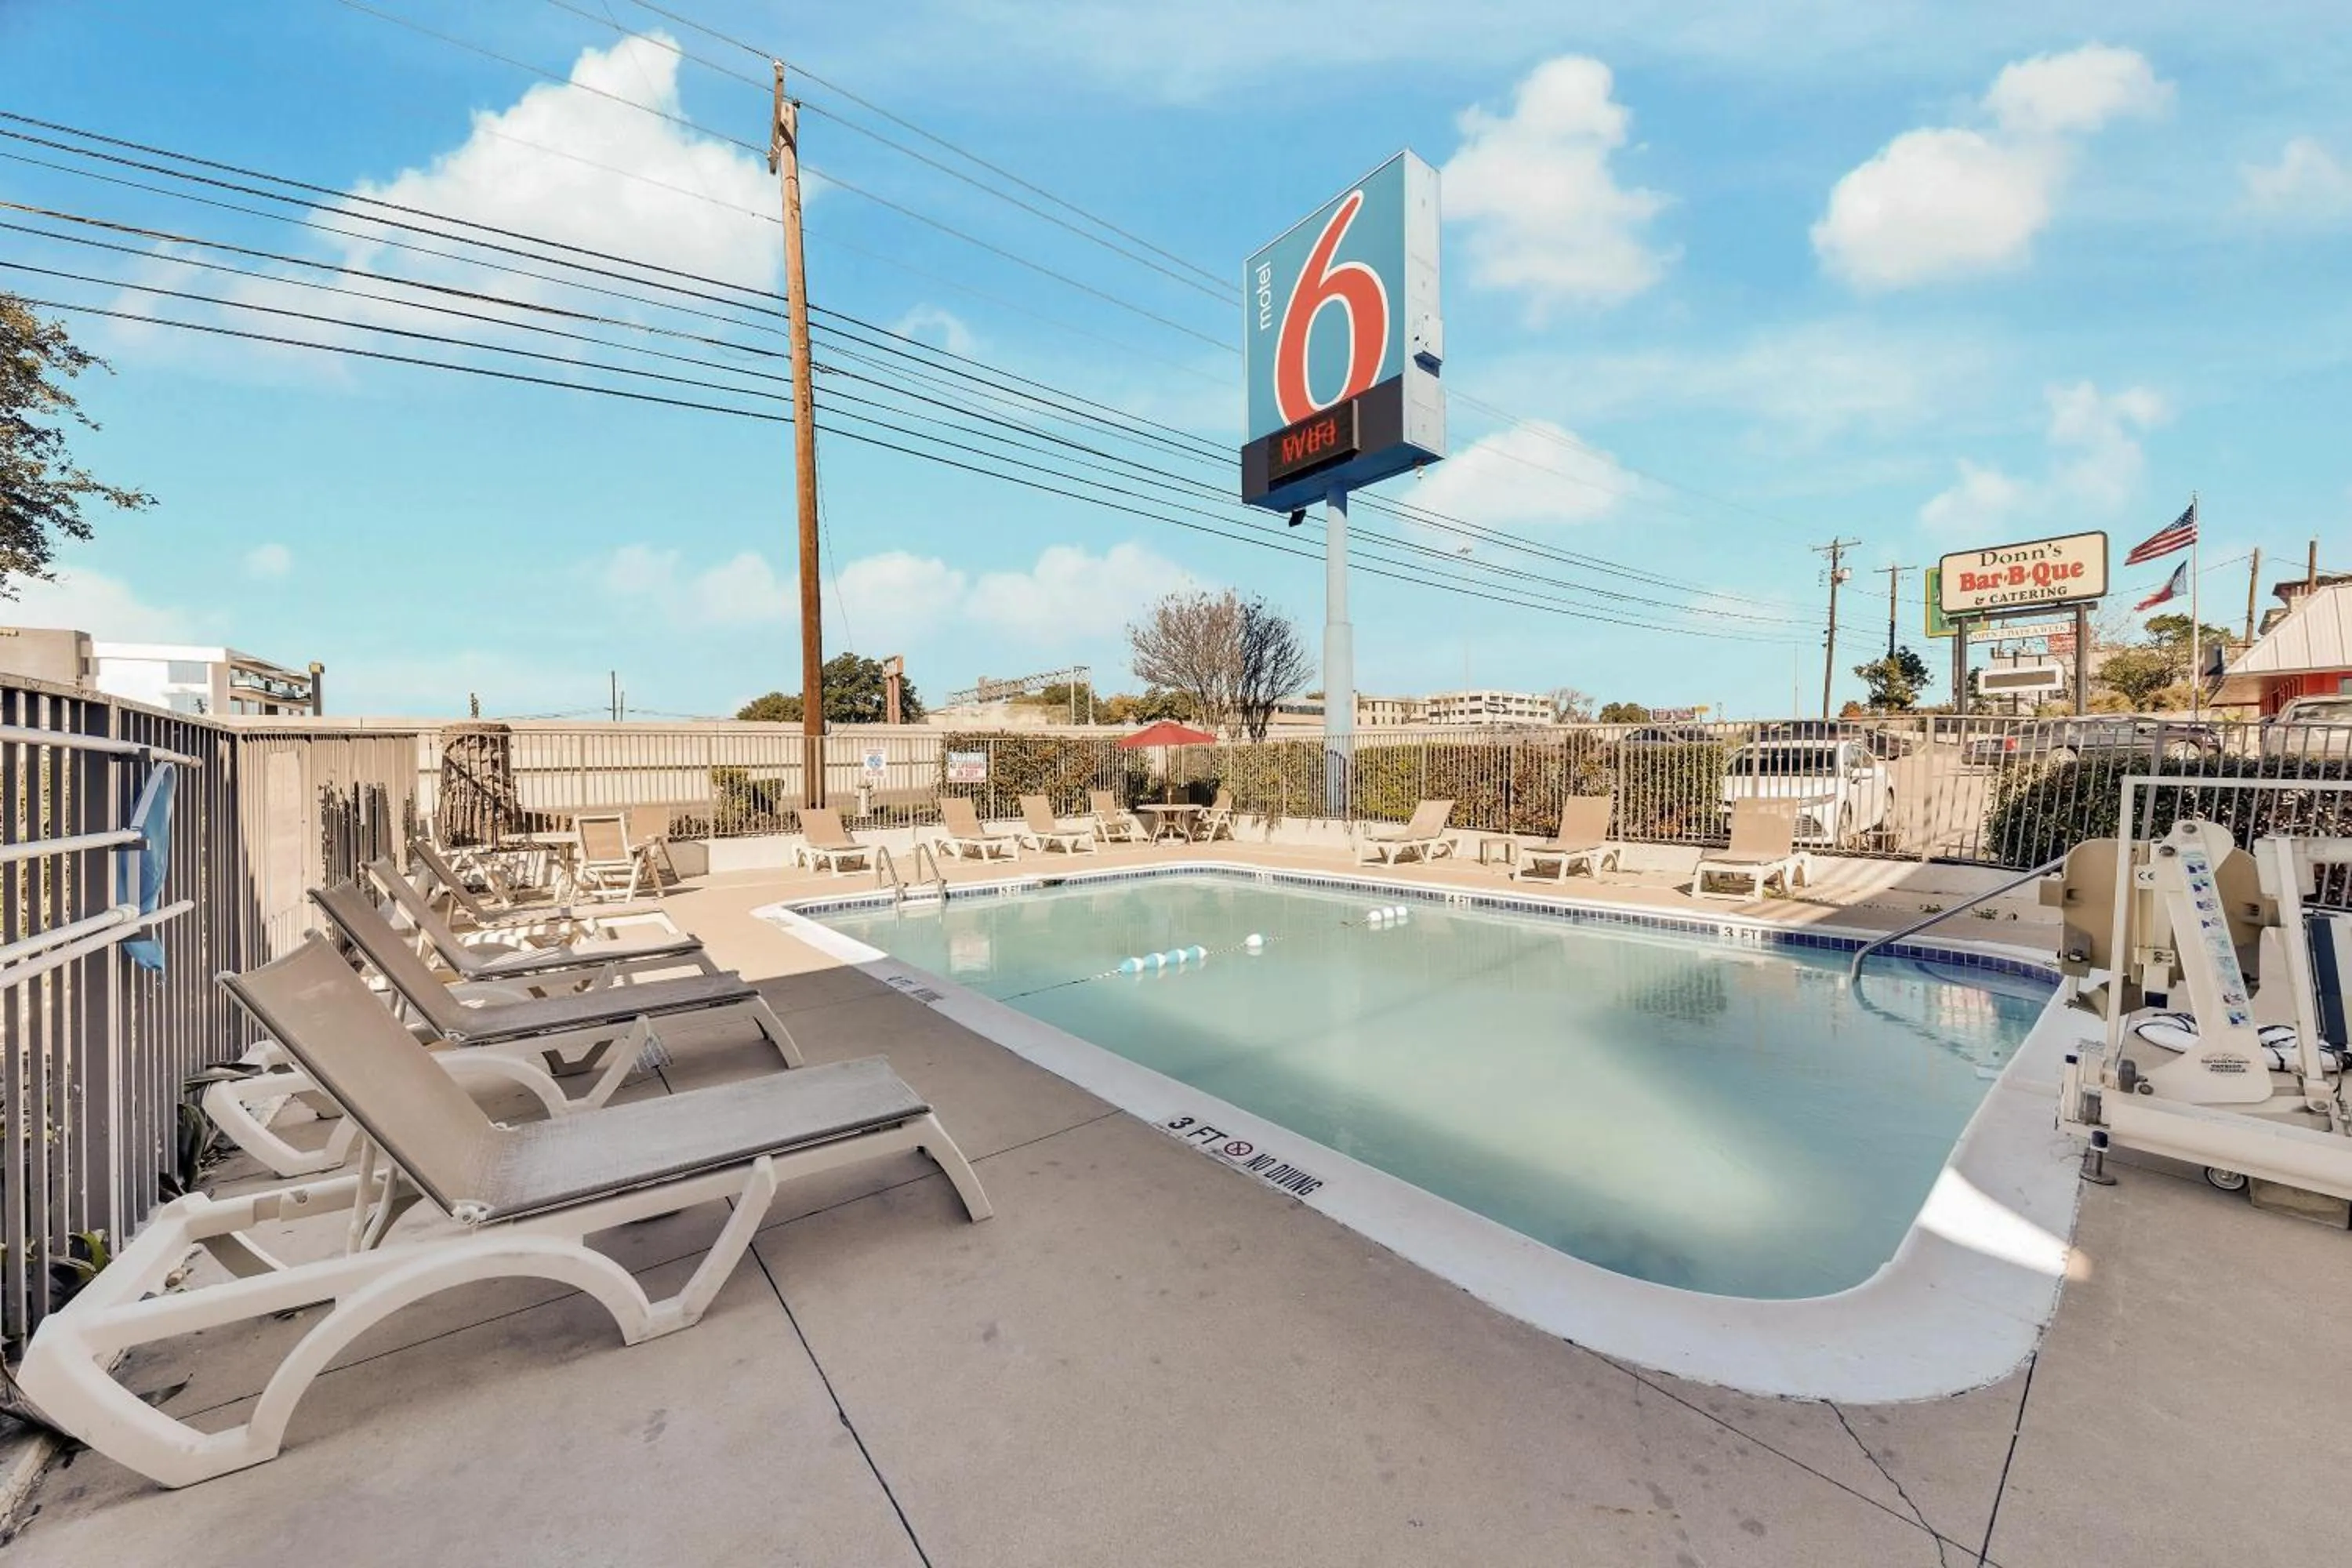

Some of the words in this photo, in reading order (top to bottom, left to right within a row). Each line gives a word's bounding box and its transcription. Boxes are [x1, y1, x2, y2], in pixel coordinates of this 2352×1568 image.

[1256, 261, 1271, 330] motel
[1275, 190, 1388, 425] 6
[1980, 543, 2063, 567] Donn's
[1975, 597, 1984, 605] &
[1989, 586, 2068, 604] CATERING
[1741, 927, 1758, 939] FT
[1168, 1117, 1195, 1130] 3
[1187, 1126, 1229, 1145] FT
[1243, 1153, 1277, 1171] NO
[1263, 1164, 1323, 1196] DIVING
